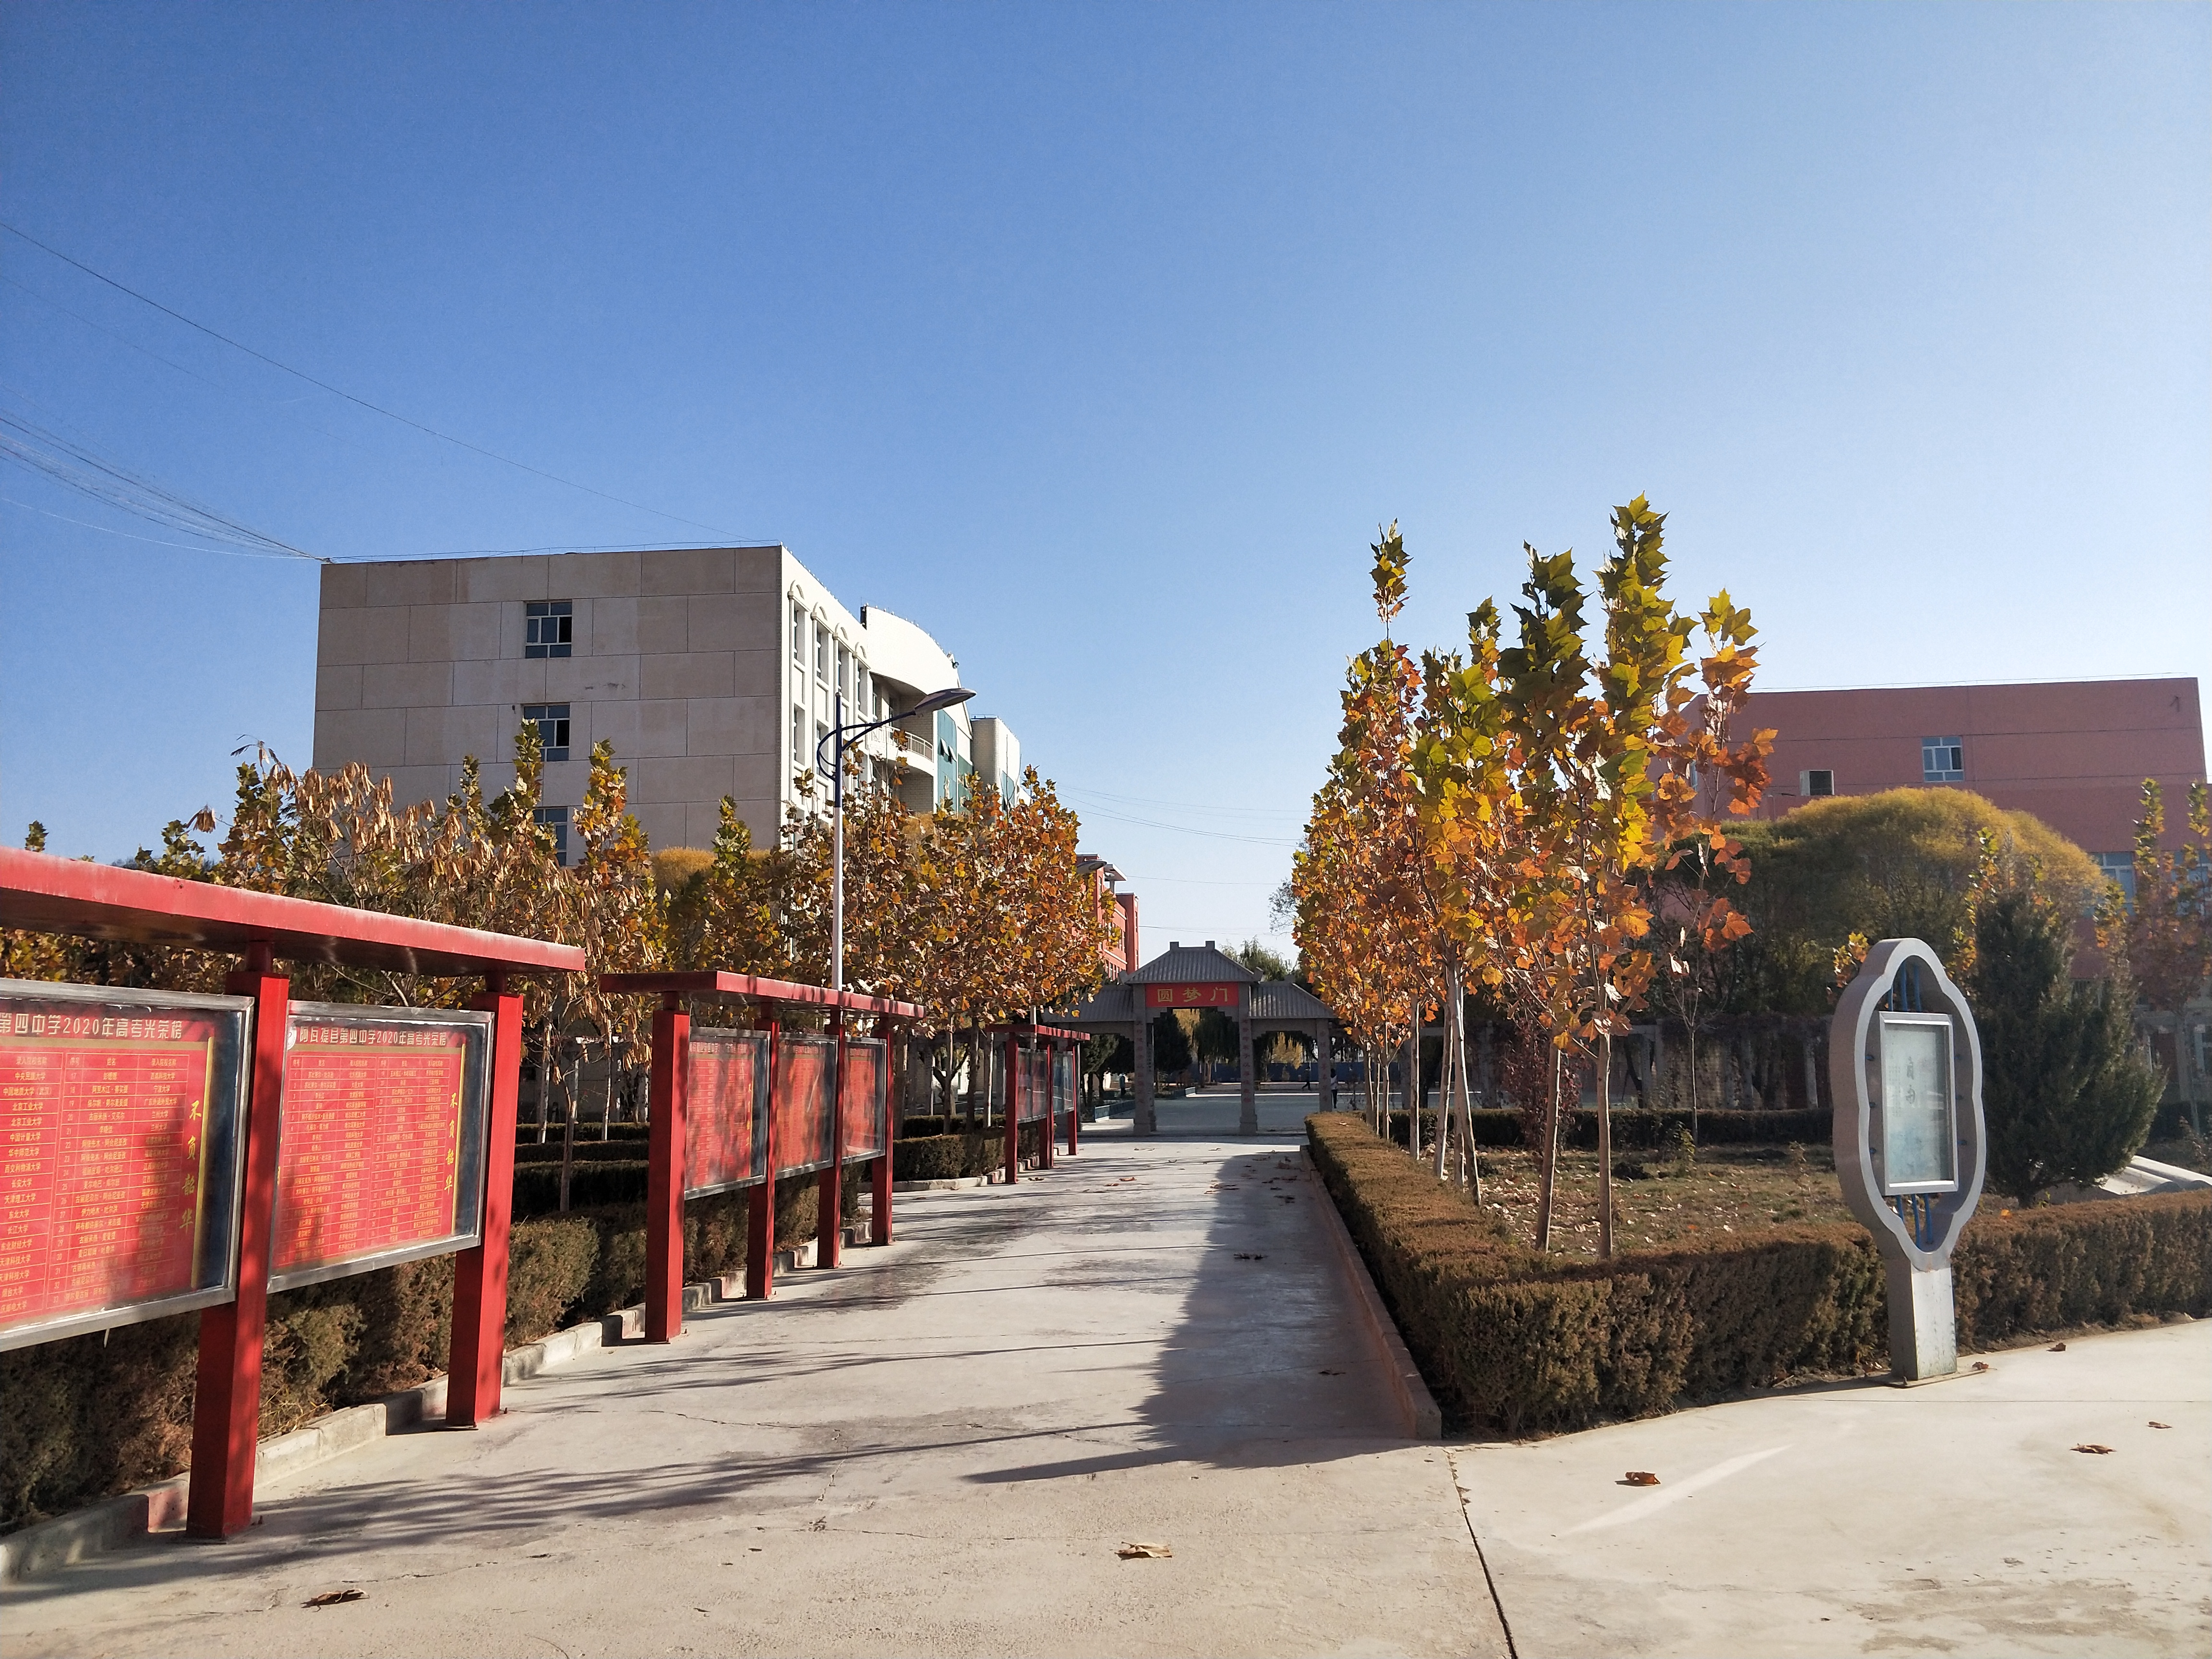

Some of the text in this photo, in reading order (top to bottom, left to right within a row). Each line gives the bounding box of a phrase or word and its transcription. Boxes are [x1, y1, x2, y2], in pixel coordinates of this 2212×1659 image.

[1157, 987, 1227, 1002] 圆梦门
[12, 1102, 43, 1111] 北京工业大学
[11, 1117, 42, 1126] 北京工业大学
[180, 1100, 201, 1234] 不负韶华
[8, 1209, 29, 1219] 东北大学
